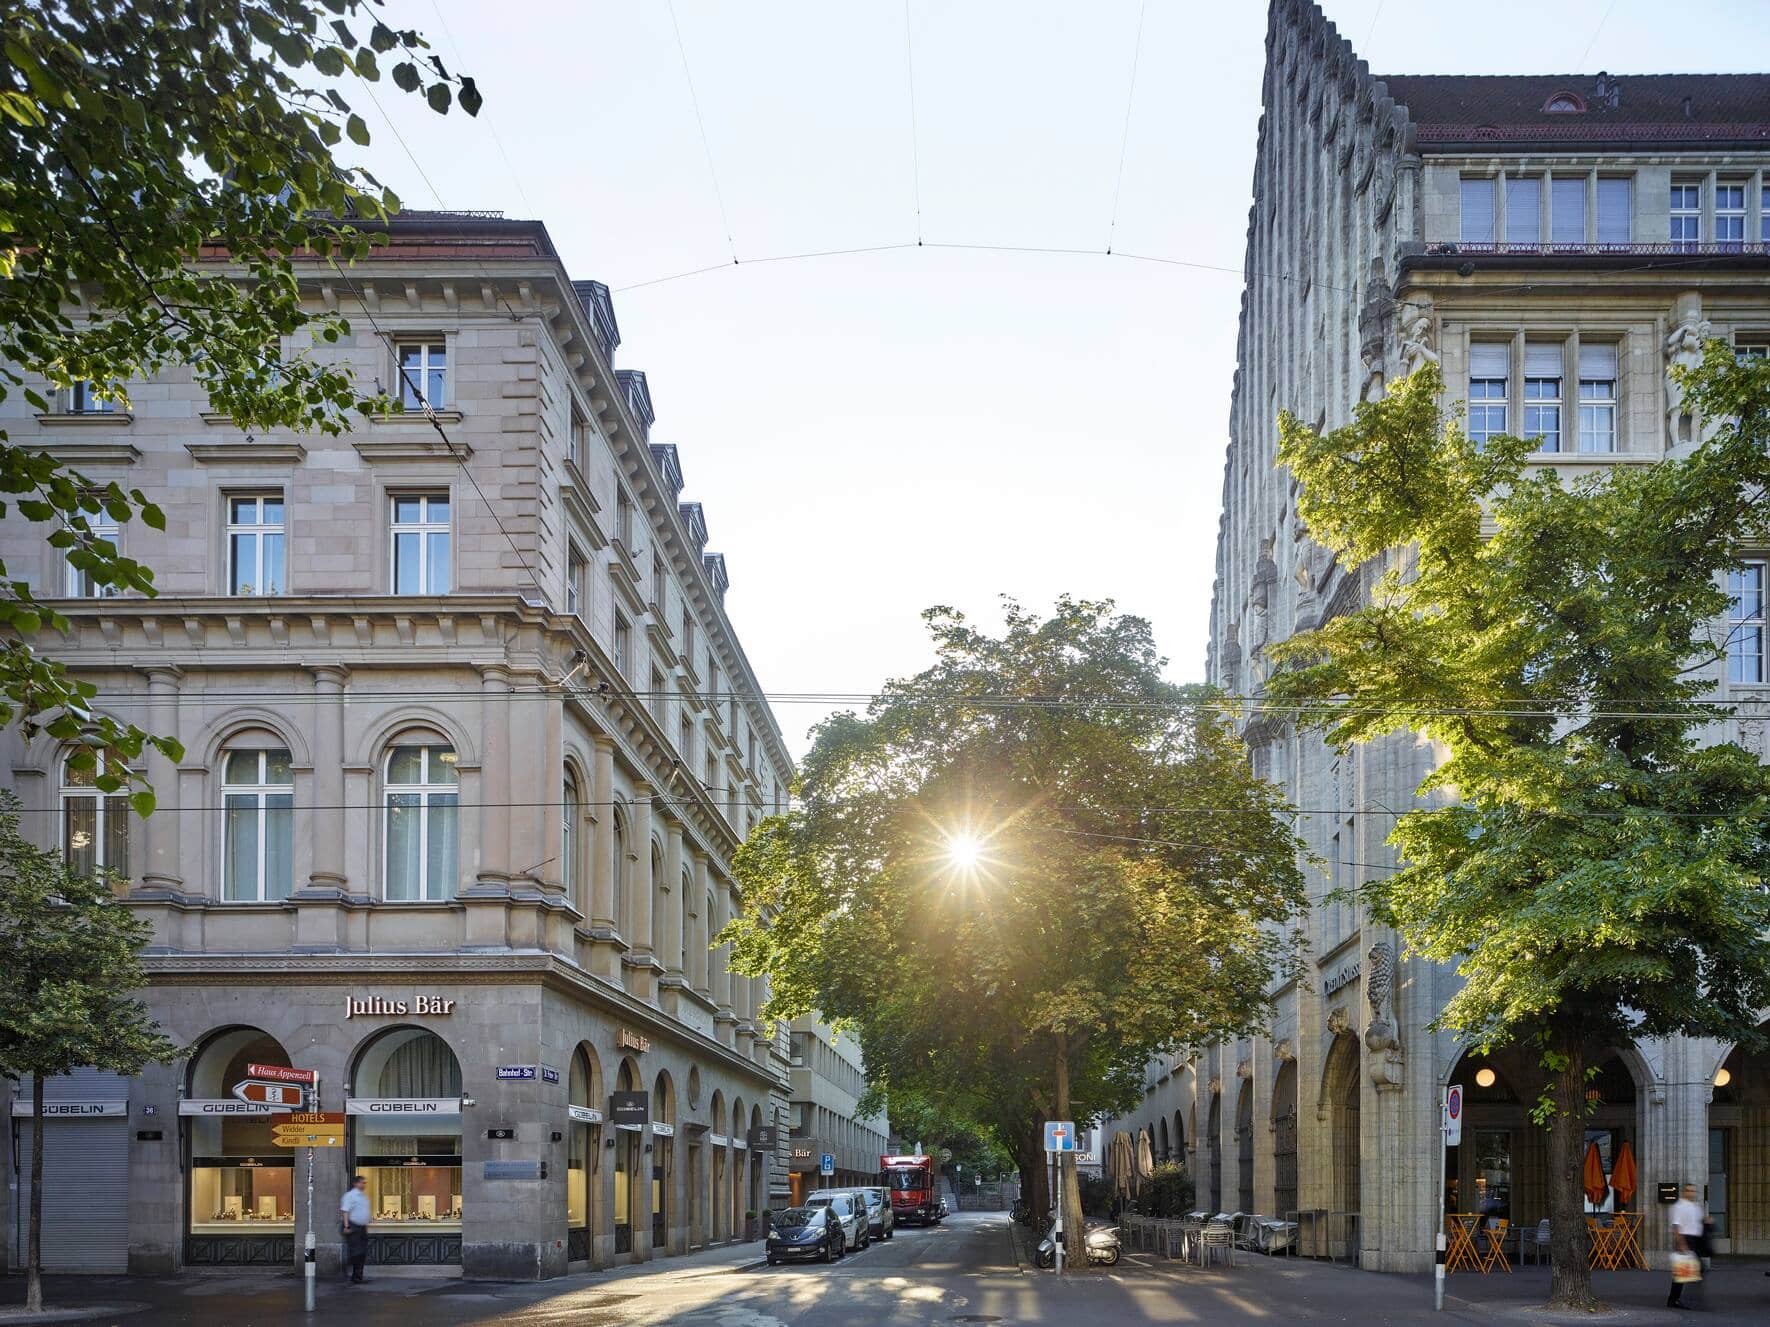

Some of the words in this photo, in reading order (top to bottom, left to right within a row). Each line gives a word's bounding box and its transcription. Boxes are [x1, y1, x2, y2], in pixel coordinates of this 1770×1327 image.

[344, 996, 407, 1019] Julius
[415, 995, 454, 1014] Bär
[257, 1067, 276, 1077] Haus
[277, 1069, 312, 1080] Appenzell
[203, 1103, 270, 1113] GÜBELIN
[369, 1103, 437, 1112] GÜBELIN
[291, 1114, 326, 1123] HOTELS
[282, 1125, 305, 1133] Widder
